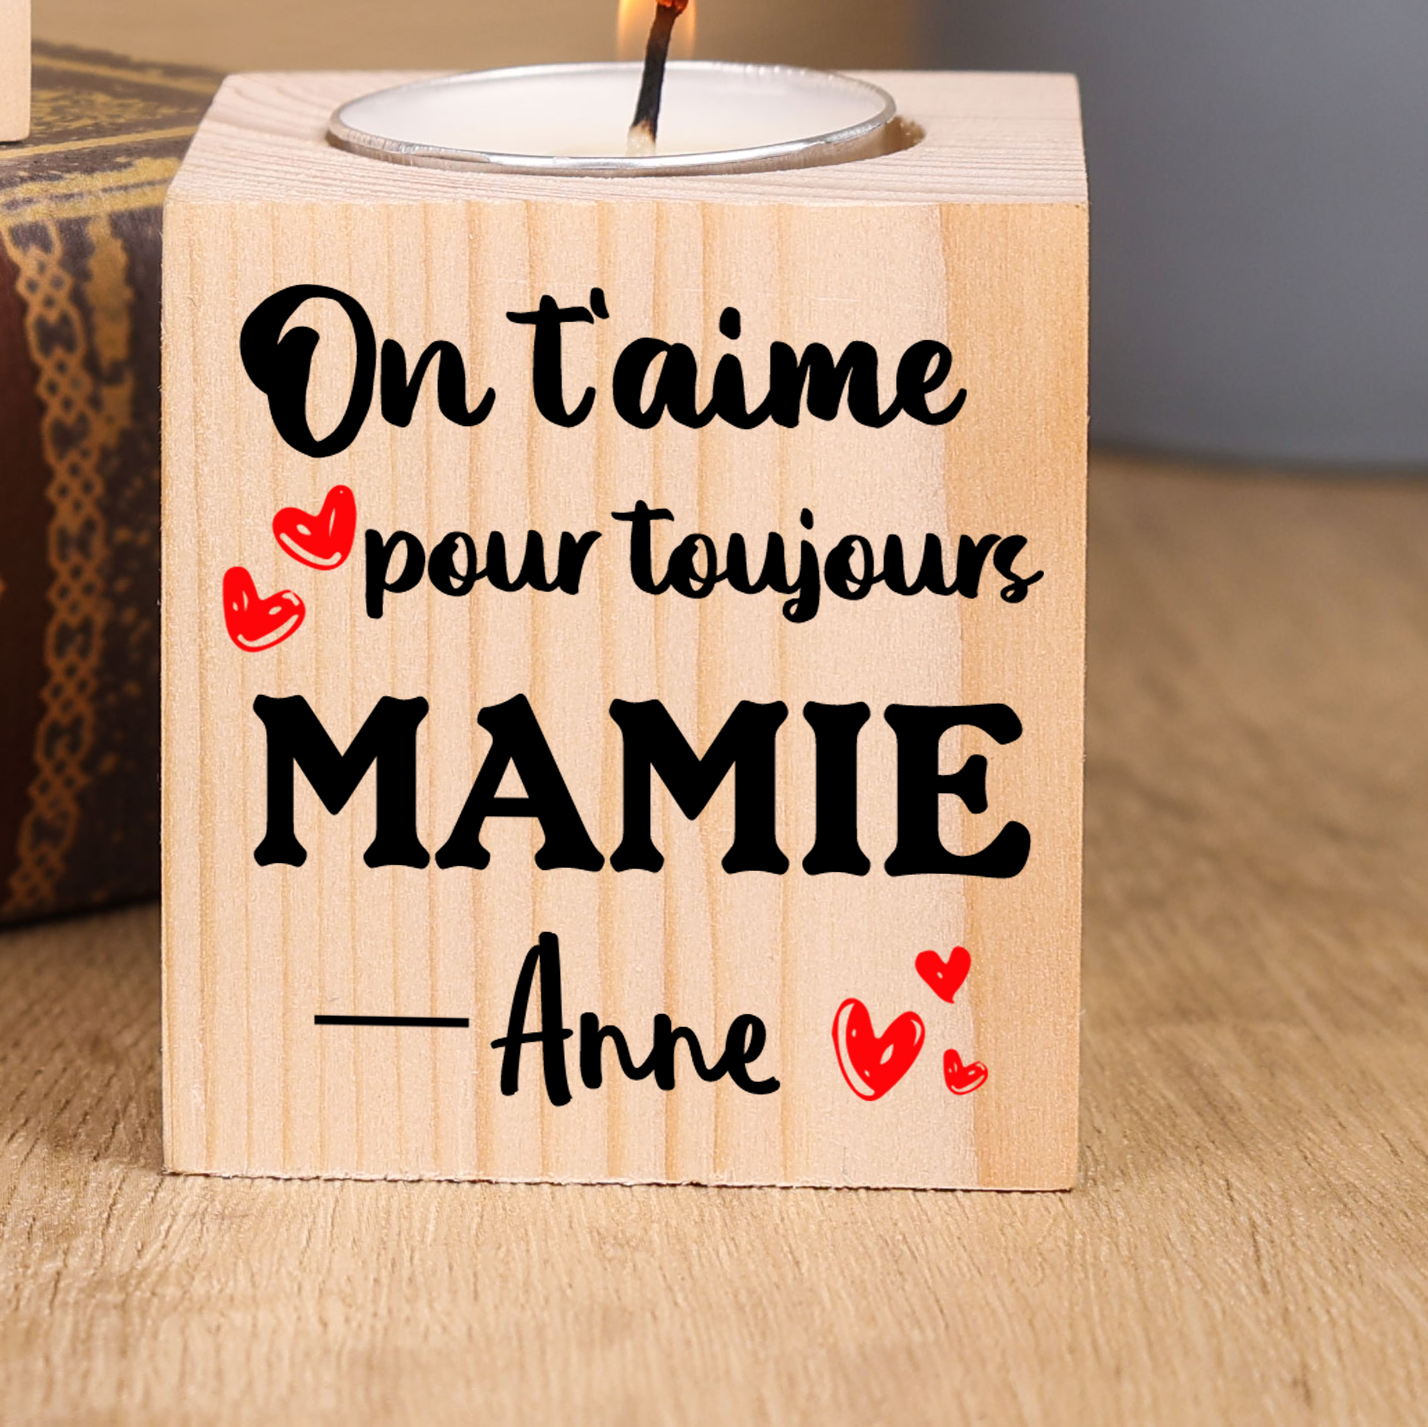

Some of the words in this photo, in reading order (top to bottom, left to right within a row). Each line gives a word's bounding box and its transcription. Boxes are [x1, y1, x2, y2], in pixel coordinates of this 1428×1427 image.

[239, 284, 496, 458] On
[506, 287, 967, 430] t'aime
[365, 527, 602, 619] pour
[611, 499, 1045, 624] toujours
[252, 692, 1031, 879] MAMIE
[490, 931, 781, 1107] Anne
